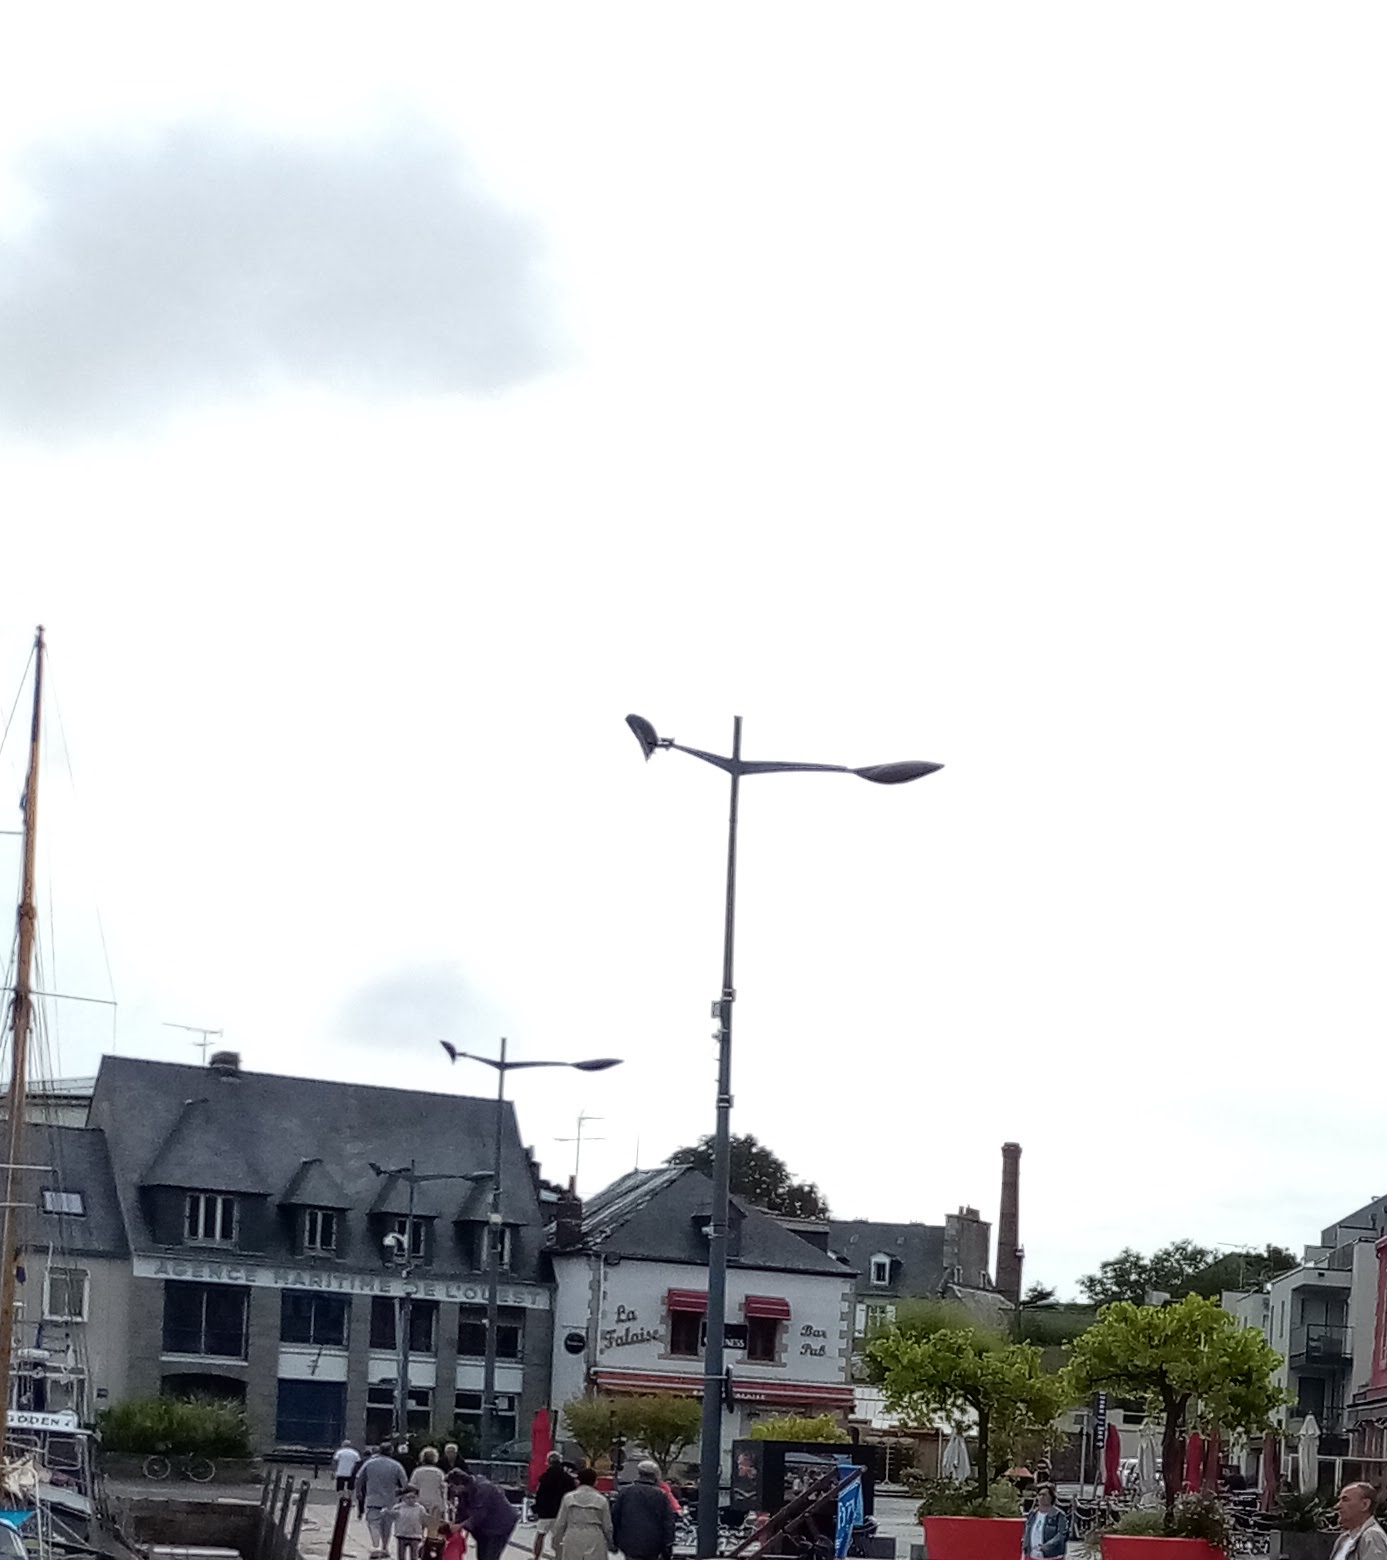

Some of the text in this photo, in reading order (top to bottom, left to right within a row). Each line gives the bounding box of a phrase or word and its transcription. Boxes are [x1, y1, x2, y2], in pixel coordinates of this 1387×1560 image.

[153, 1260, 257, 1282] AGENCE
[273, 1269, 392, 1294] MARITIME
[615, 1304, 638, 1323] La
[603, 1326, 660, 1350] Falaise
[799, 1324, 828, 1339] Bar
[799, 1343, 827, 1357] Pub
